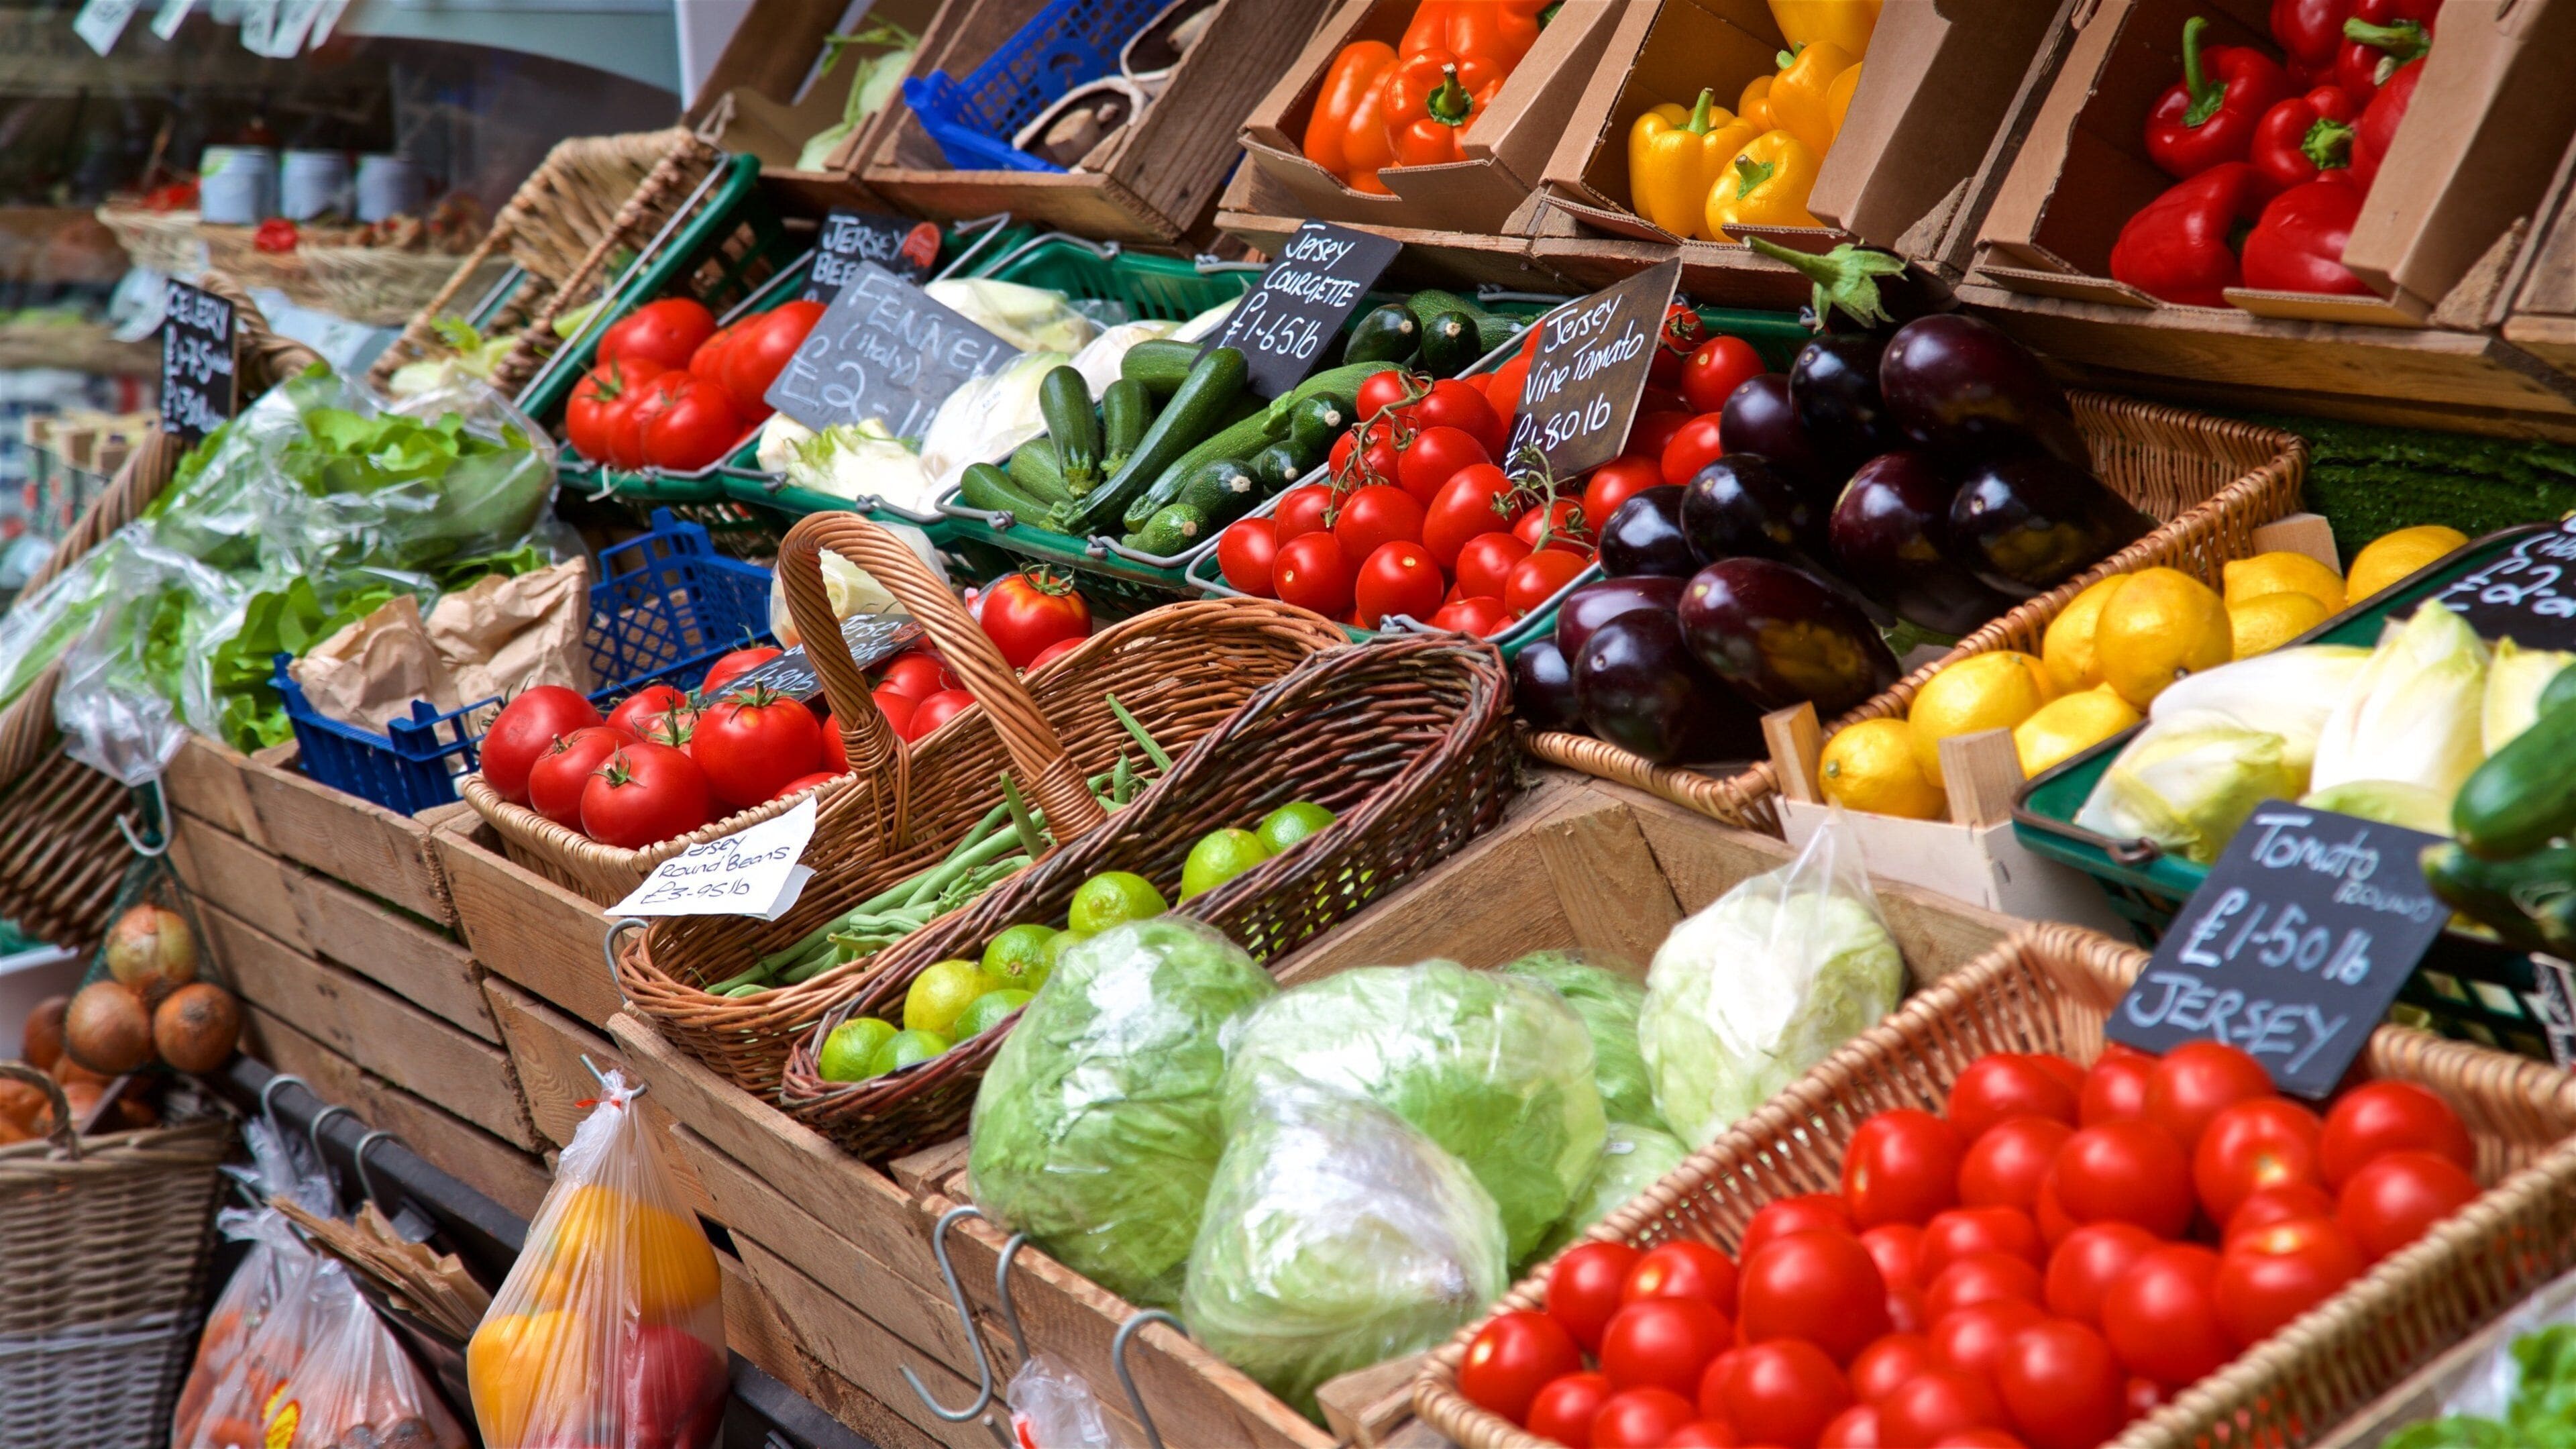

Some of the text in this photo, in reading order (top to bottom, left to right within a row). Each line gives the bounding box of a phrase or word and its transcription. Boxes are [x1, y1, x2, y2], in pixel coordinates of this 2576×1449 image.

[822, 214, 908, 261] JERSEY
[1285, 223, 1356, 271] Jersey
[1263, 261, 1361, 307] COURGETTE
[1544, 293, 1623, 354] Jersey
[1525, 319, 1645, 406] Vine Tomato
[658, 846, 791, 878] Round Beans
[679, 835, 747, 859] ersey
[2251, 813, 2381, 881] Tomato
[2124, 971, 2349, 1074] JERSEY
